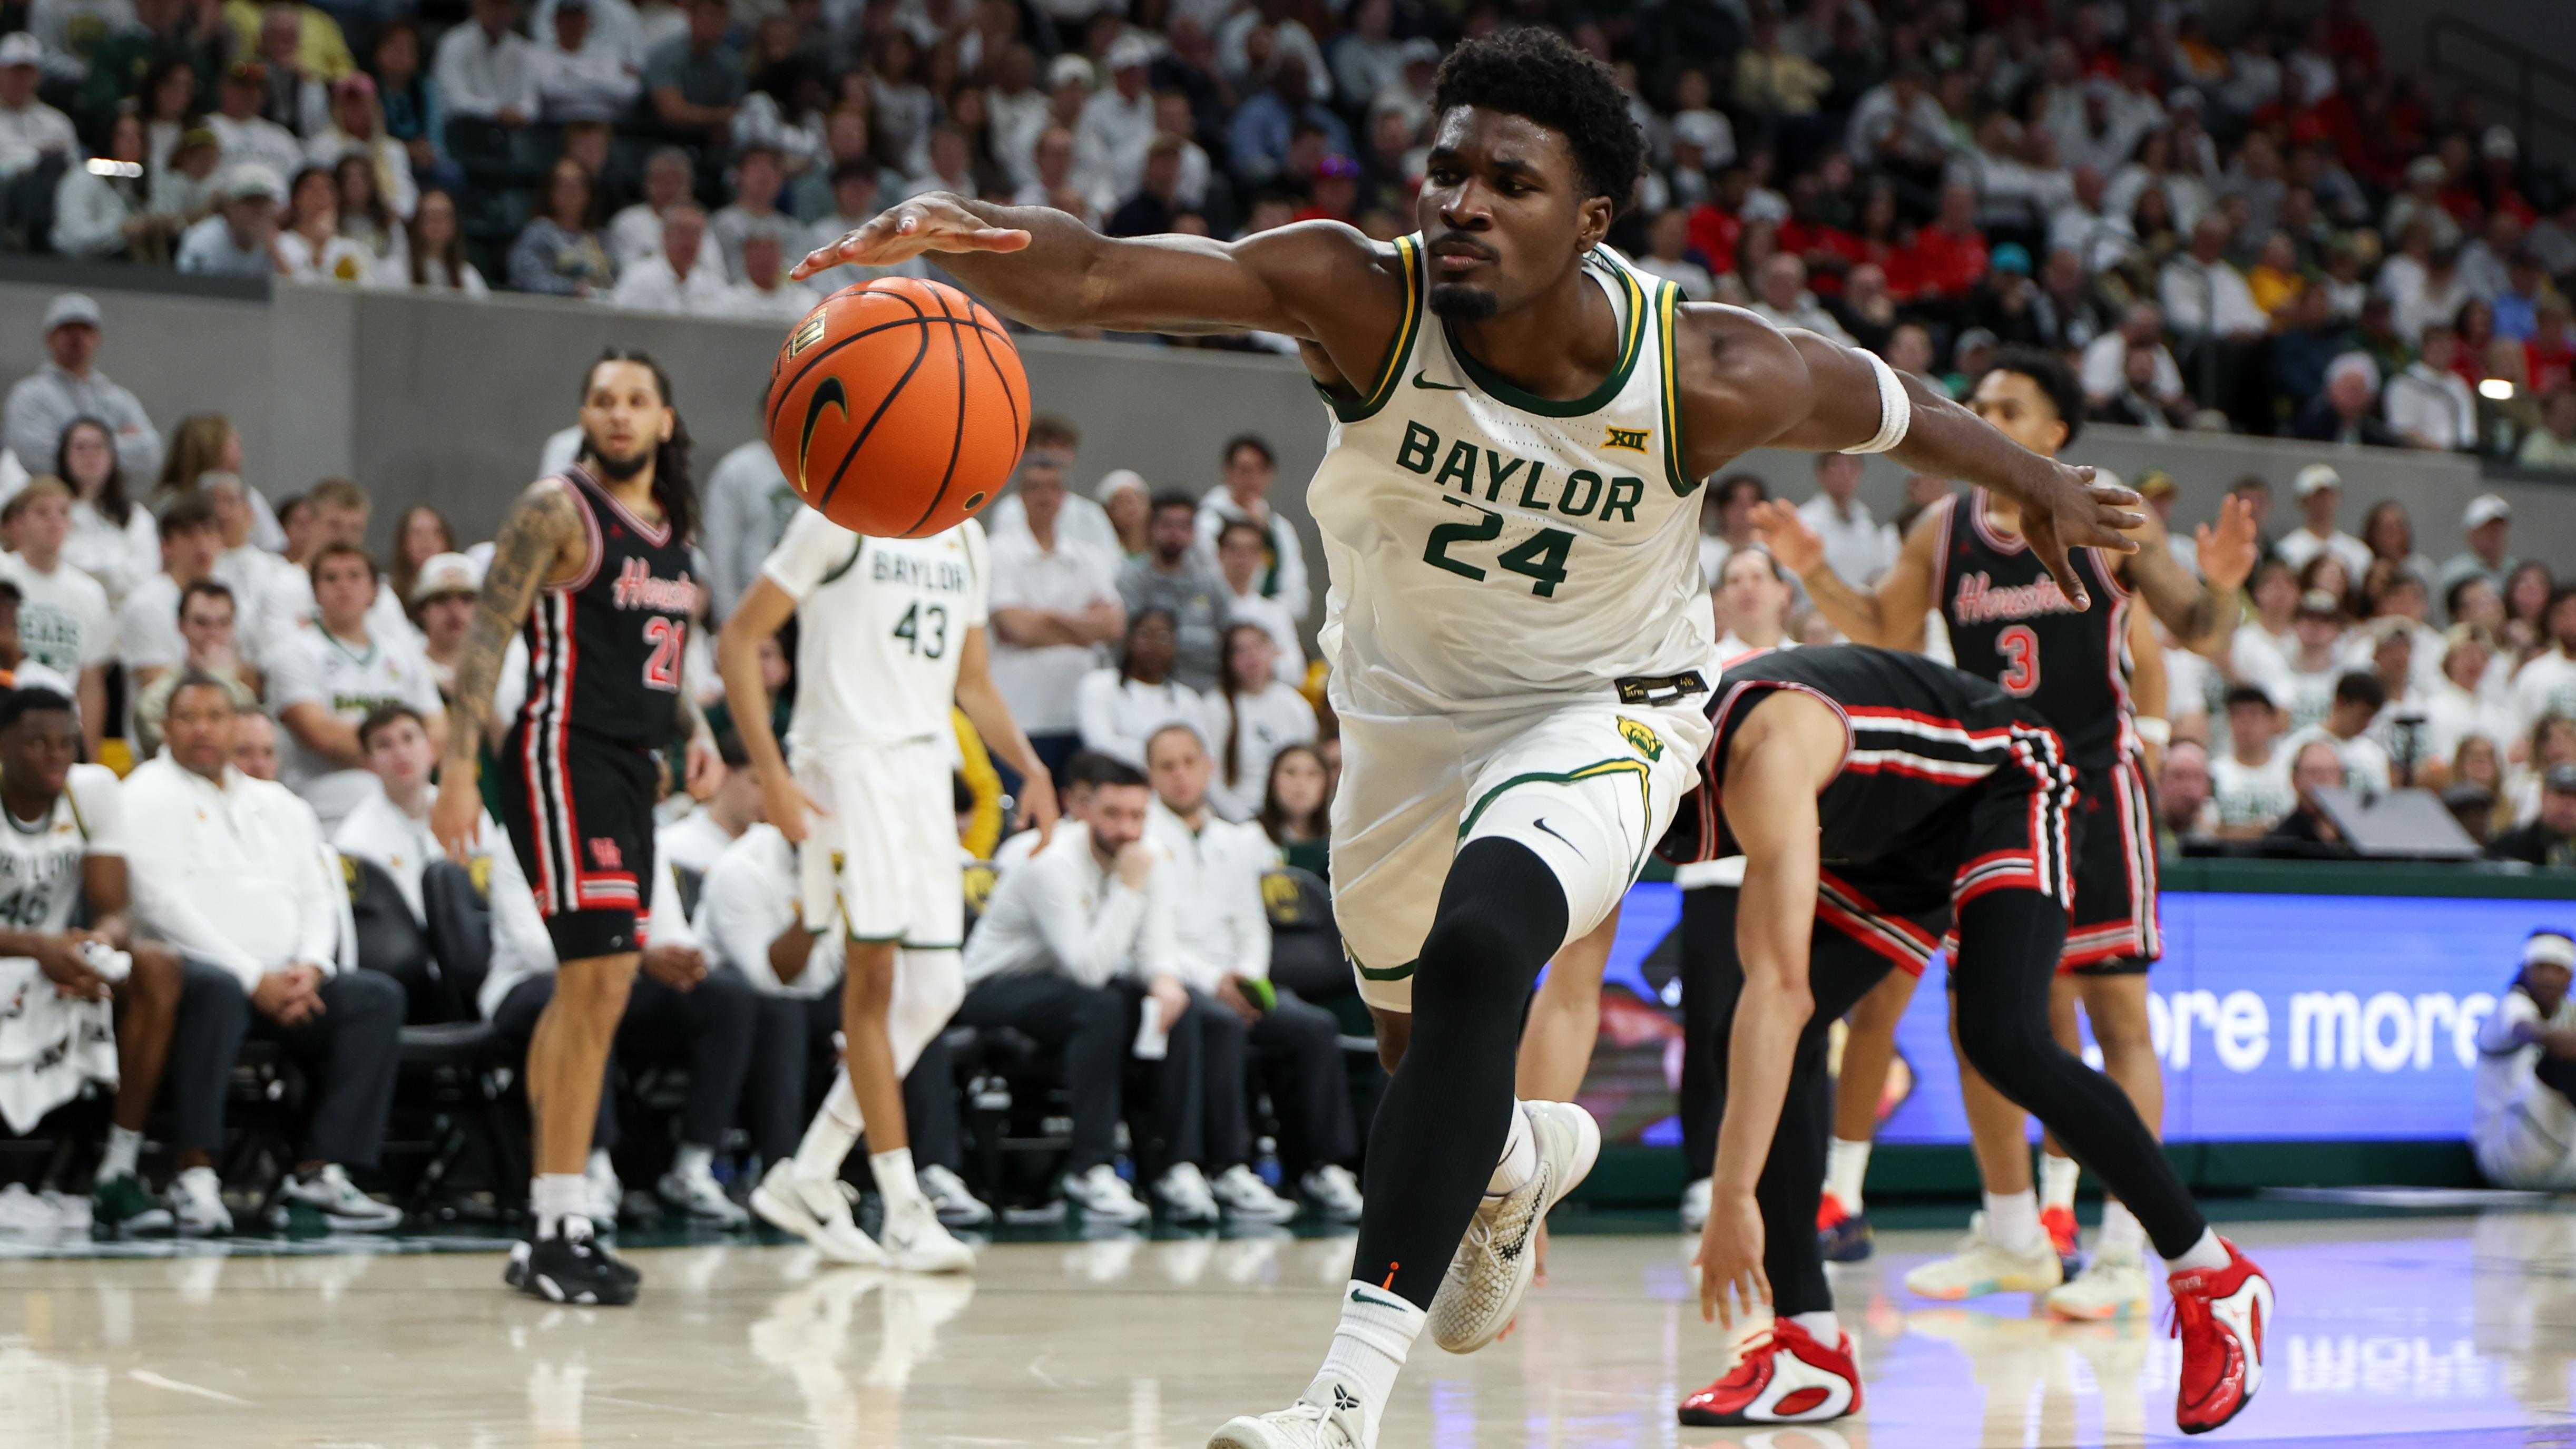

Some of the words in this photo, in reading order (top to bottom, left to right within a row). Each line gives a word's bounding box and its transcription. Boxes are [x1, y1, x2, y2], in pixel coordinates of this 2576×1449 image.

[1396, 420, 1644, 523] BAYLOR
[1603, 427, 1650, 454] XII
[873, 551, 967, 593] BAYLOR
[1423, 495, 1577, 598] 24
[642, 615, 687, 694] 21
[893, 602, 948, 659] 43
[1995, 624, 2041, 698] 3
